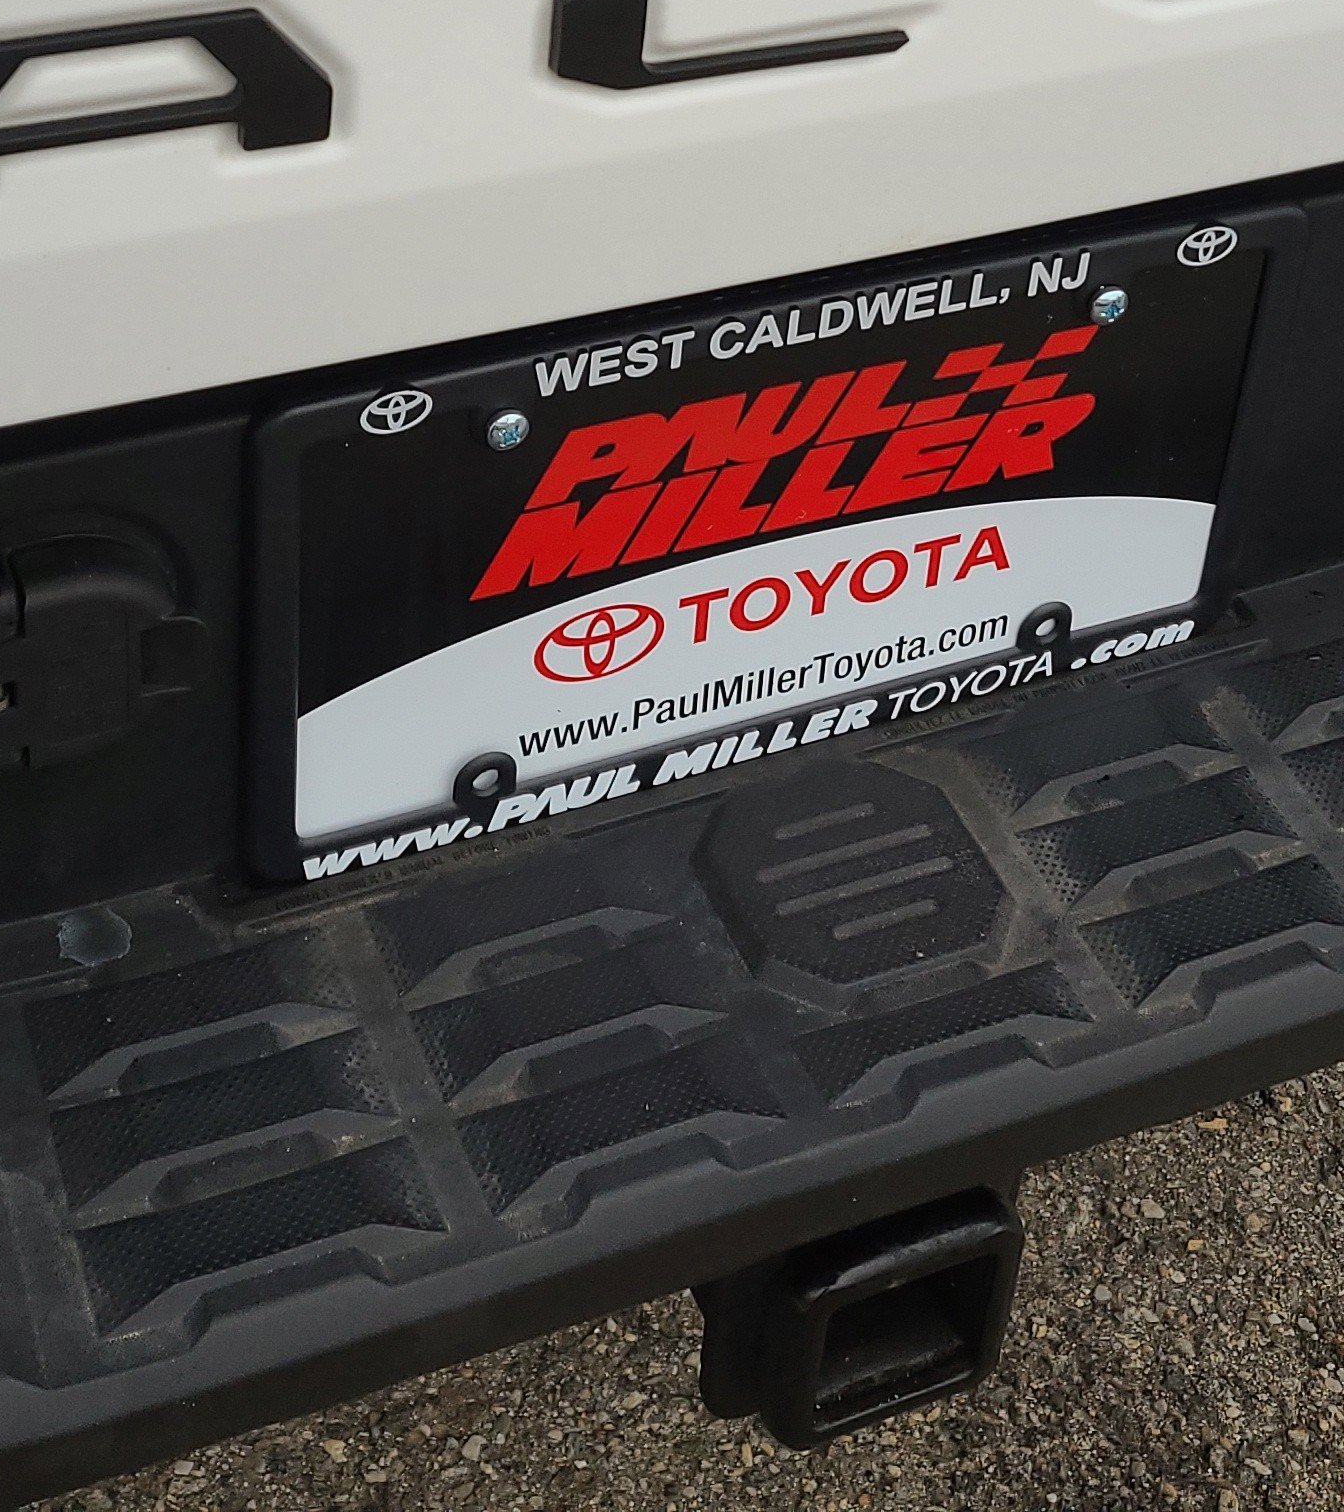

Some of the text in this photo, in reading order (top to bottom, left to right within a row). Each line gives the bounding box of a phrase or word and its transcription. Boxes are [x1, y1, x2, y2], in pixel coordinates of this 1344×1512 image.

[534, 252, 1092, 398] WEST CALDWELL, NJ
[469, 392, 1096, 603] MILLER
[524, 360, 914, 511] PAUL
[678, 525, 1011, 645] TOYOTA
[517, 613, 1010, 758] www.PaulMillerToyota.com
[653, 699, 880, 786] MILLER
[888, 650, 1054, 723] TOYOTA
[1069, 618, 1196, 671] .com
